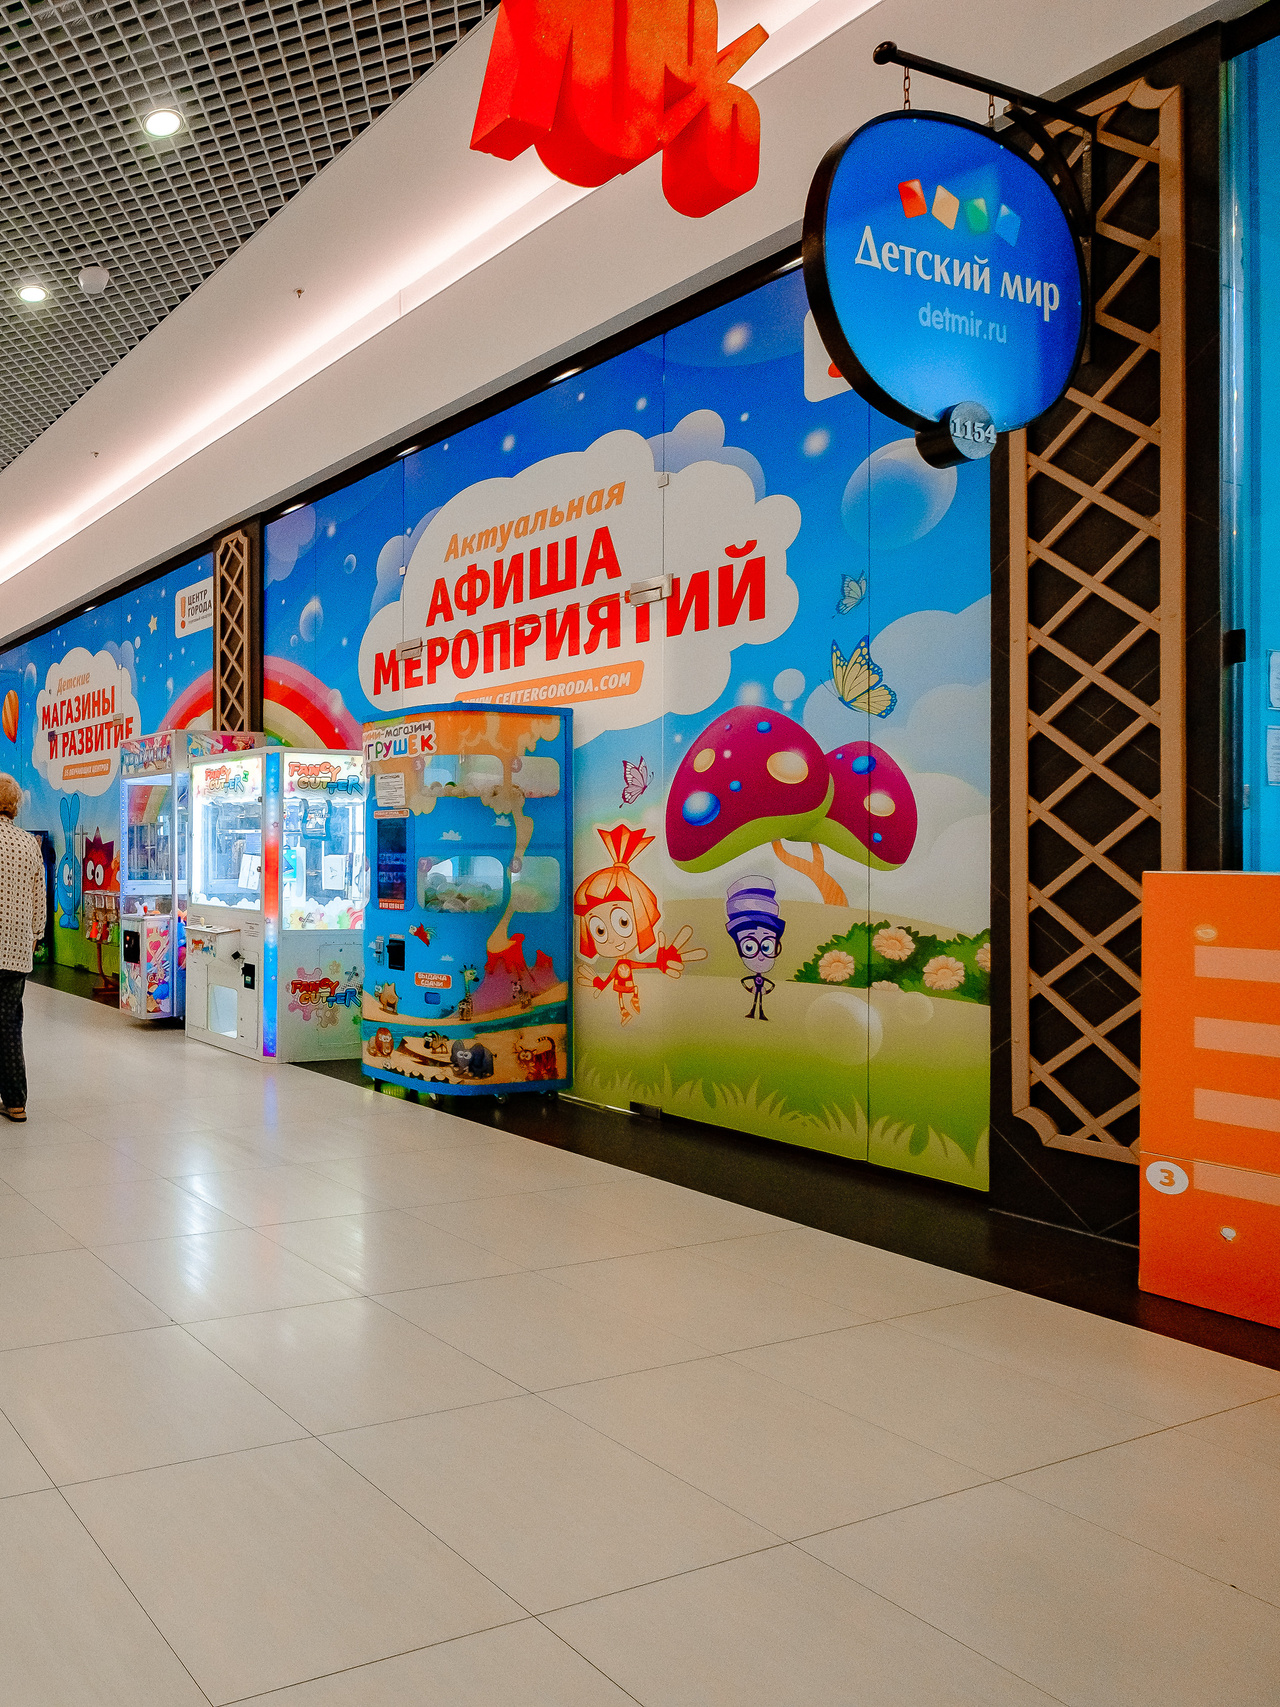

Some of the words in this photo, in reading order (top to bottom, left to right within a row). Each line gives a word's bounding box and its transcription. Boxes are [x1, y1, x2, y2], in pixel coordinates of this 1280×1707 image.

[854, 225, 991, 295] Детский
[1000, 271, 1060, 322] мир
[918, 302, 1008, 345] detmir.ru
[951, 418, 997, 444] 1154
[443, 481, 627, 563] Актуальная
[425, 526, 622, 626] АФИША
[187, 589, 208, 606] ЦЕНТР
[187, 599, 213, 618] ГОРОДА
[373, 539, 766, 696] МЕРОПРИЯТИЙ
[57, 672, 91, 696] Детские
[42, 685, 115, 731] МАГАЗИНЫ
[49, 734, 58, 760] И
[204, 765, 231, 785] FANCY
[288, 761, 342, 783] FANCY
[208, 775, 245, 794] CUTTER
[297, 775, 363, 795] CUTTER
[291, 977, 339, 997] FANCY
[299, 988, 362, 1008] CUTTER
[1159, 1168, 1176, 1187] 3
